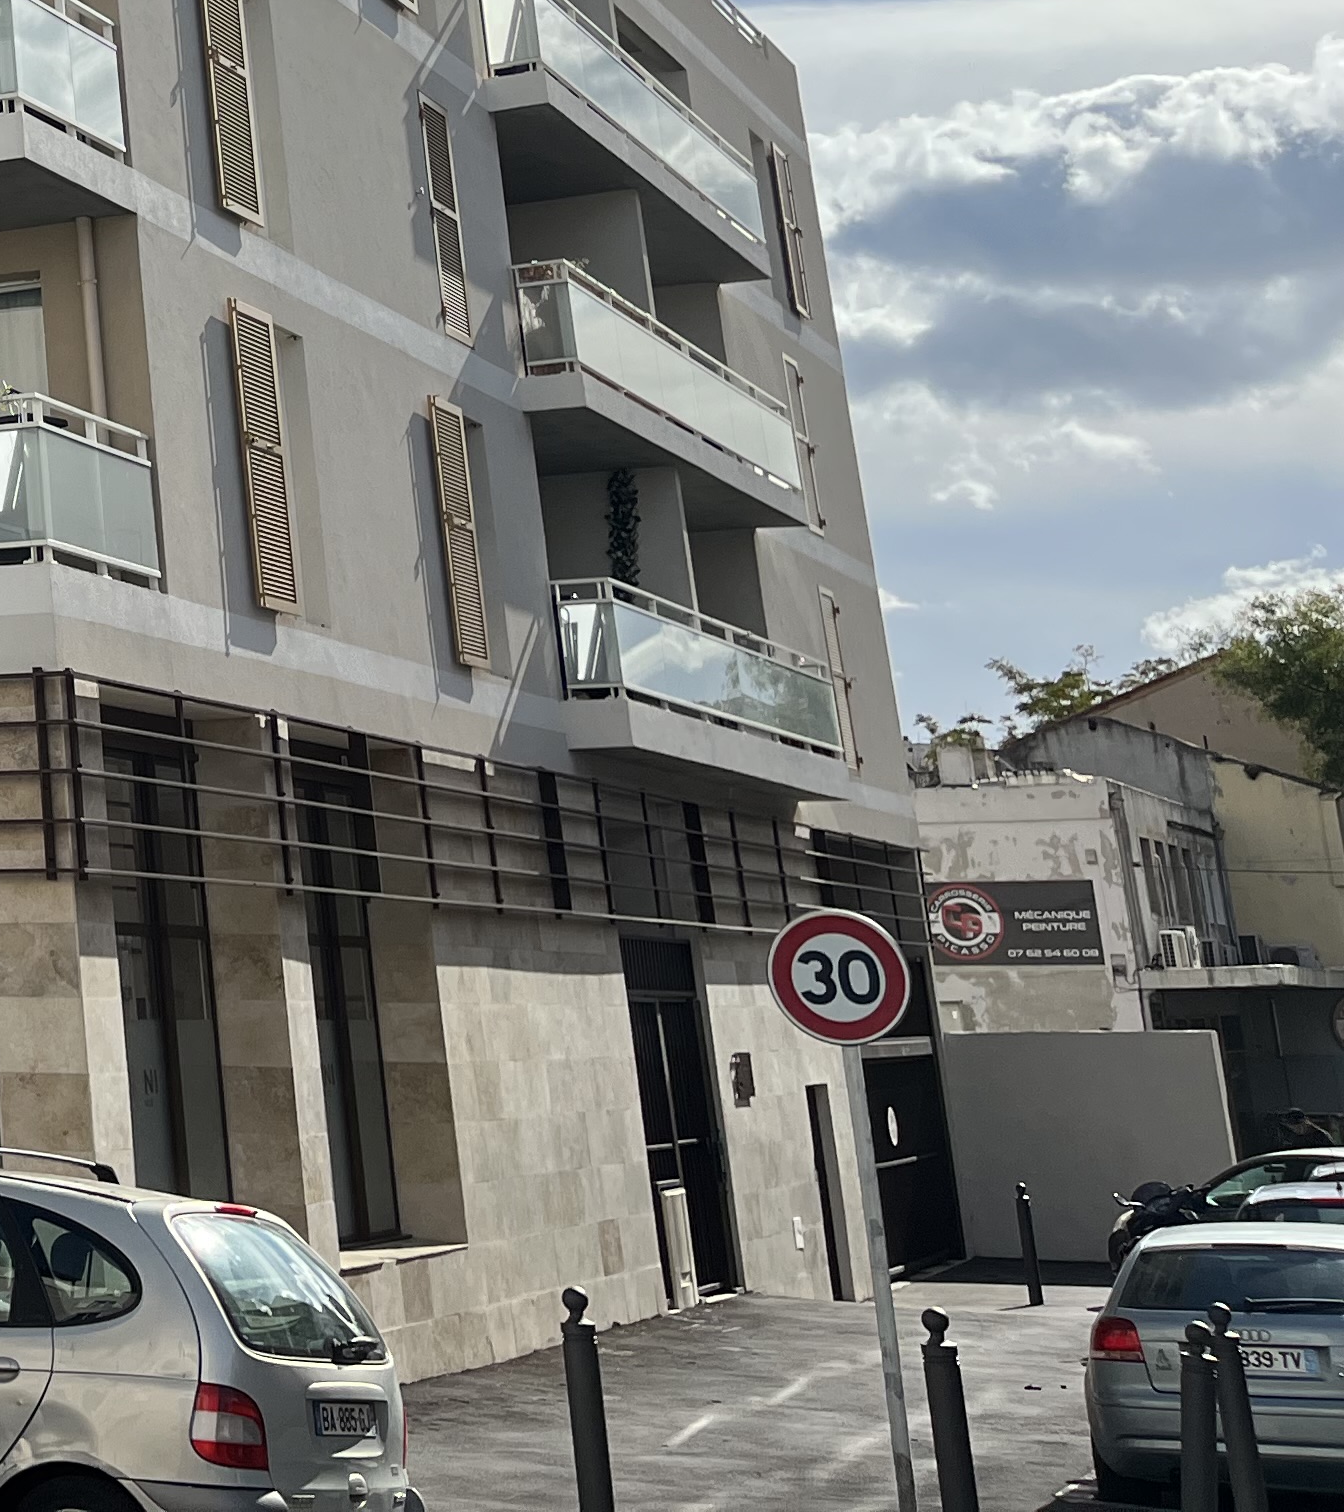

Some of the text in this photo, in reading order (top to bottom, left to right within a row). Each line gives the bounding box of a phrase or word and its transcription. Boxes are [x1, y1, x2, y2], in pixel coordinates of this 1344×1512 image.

[930, 889, 993, 912] CARROSSERIE
[1014, 910, 1091, 920] MÉCANIQUE
[1022, 922, 1086, 931] PEINTURE
[937, 934, 995, 955] PICASSO
[1007, 949, 1023, 958] 07
[797, 950, 881, 1005] 30
